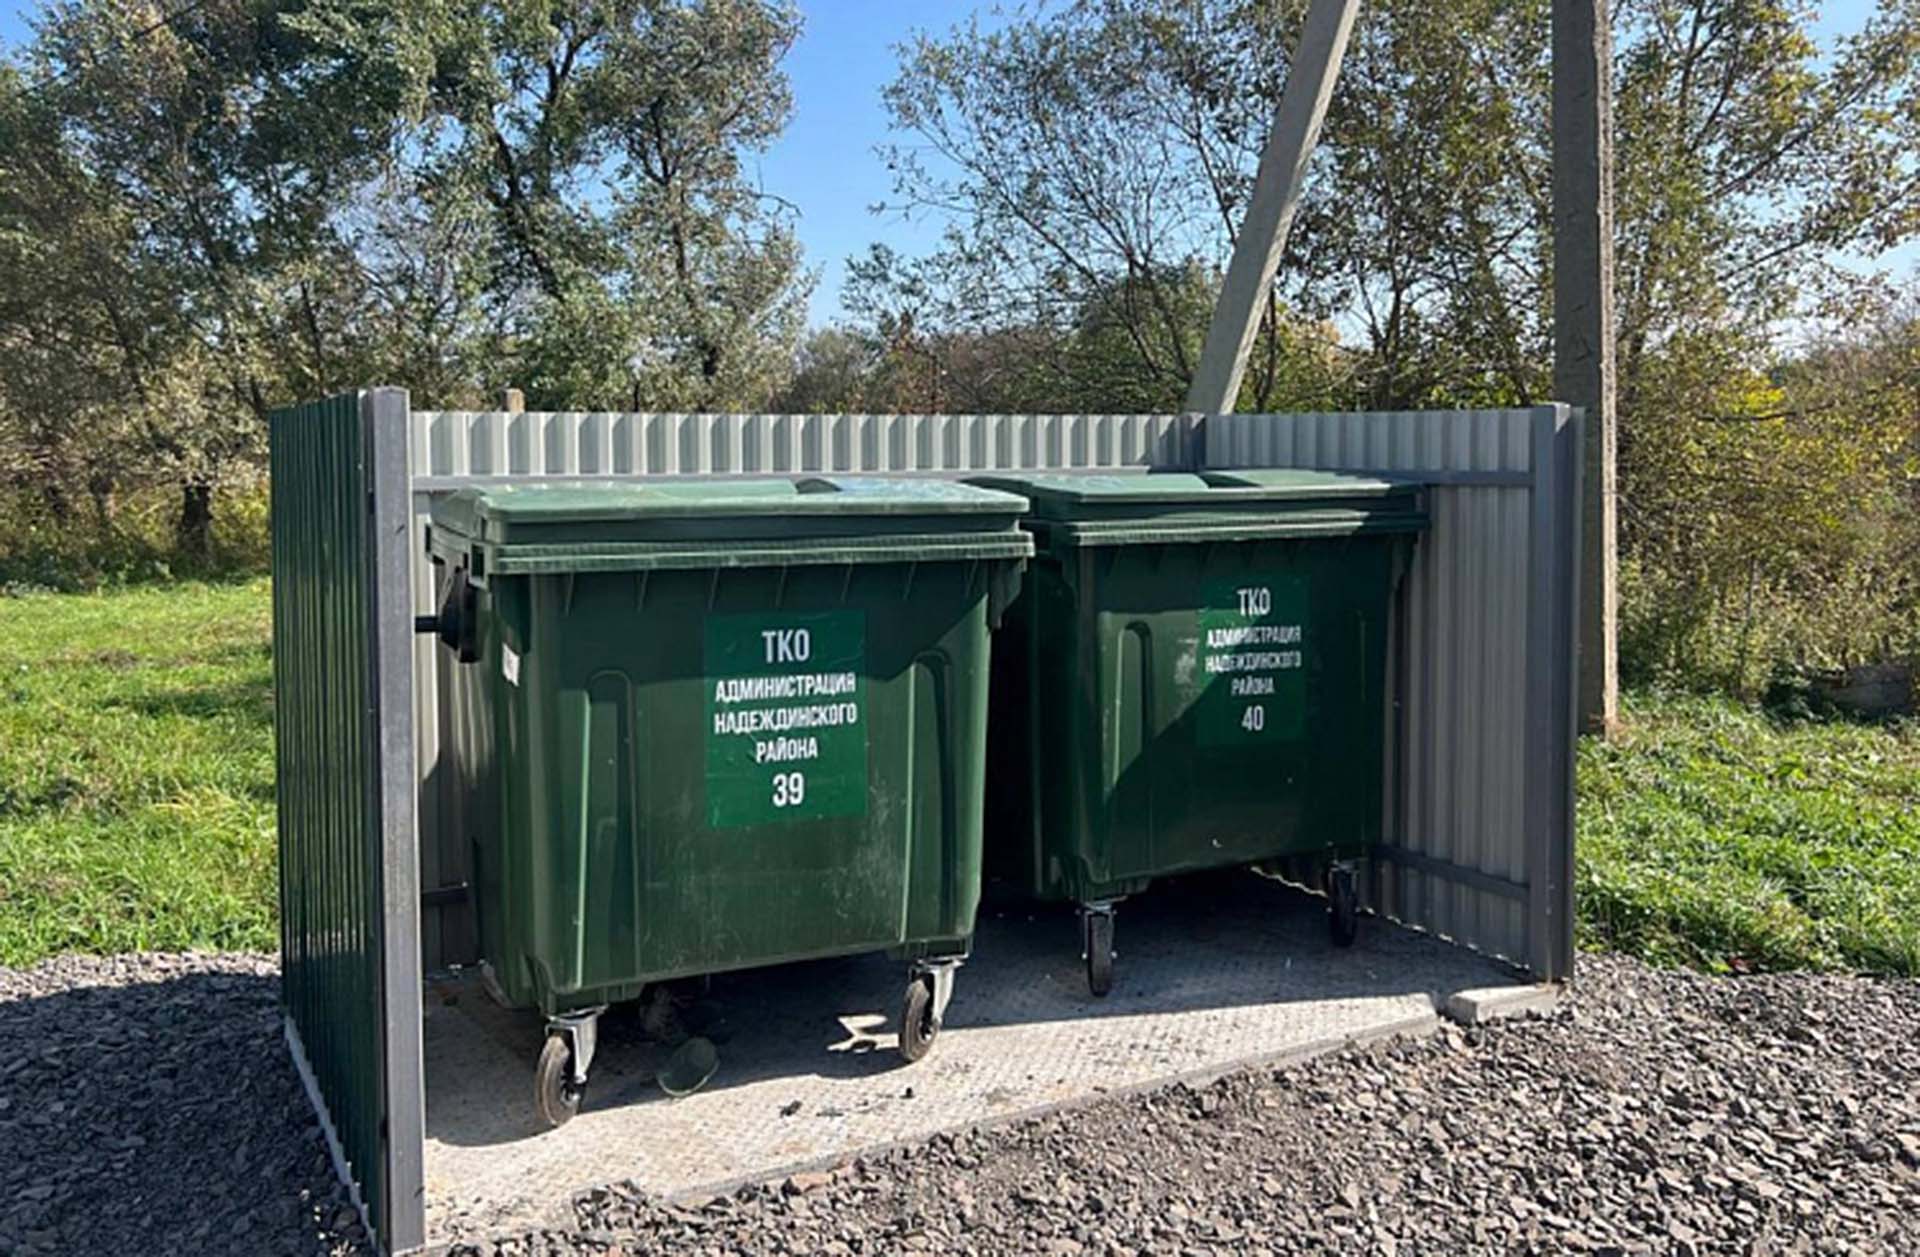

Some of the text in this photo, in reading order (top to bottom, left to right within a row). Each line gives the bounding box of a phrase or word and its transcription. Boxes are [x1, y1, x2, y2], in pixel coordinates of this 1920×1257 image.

[1237, 586, 1271, 616] ТКО
[761, 628, 810, 663] ТКО
[715, 672, 857, 703] АДМИНИСТРАЦИЯ
[1231, 675, 1275, 696] РАЙОНА
[714, 703, 858, 734] НАДЕЖДИНСКОГО
[1241, 704, 1265, 732] 40
[756, 737, 819, 763] РАЙОНА
[772, 772, 805, 807] 39
